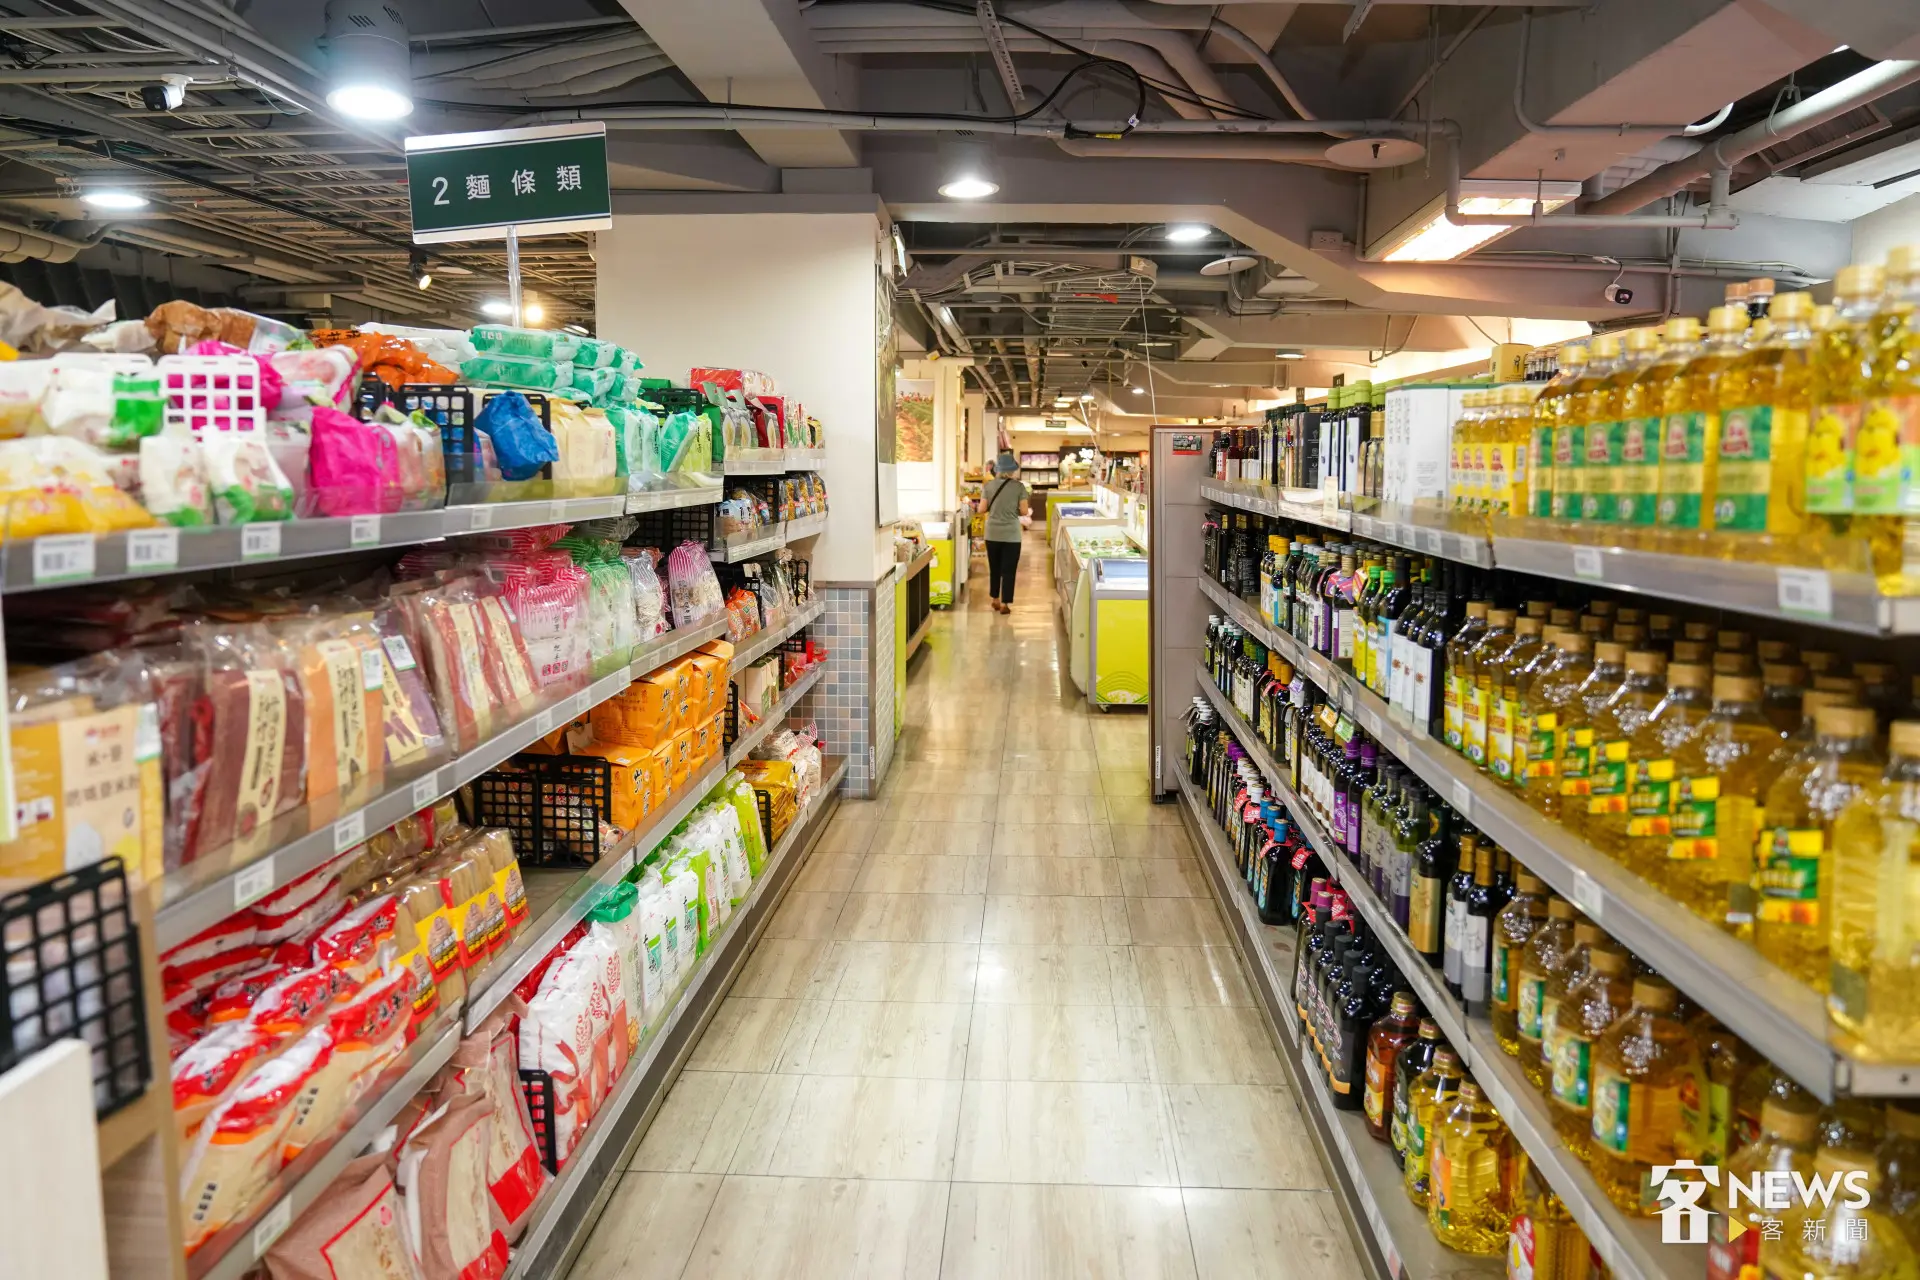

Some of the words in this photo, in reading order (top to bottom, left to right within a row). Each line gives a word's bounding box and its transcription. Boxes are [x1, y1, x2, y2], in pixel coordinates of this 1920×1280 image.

[431, 176, 450, 206] 2
[465, 164, 582, 200] 麵條類
